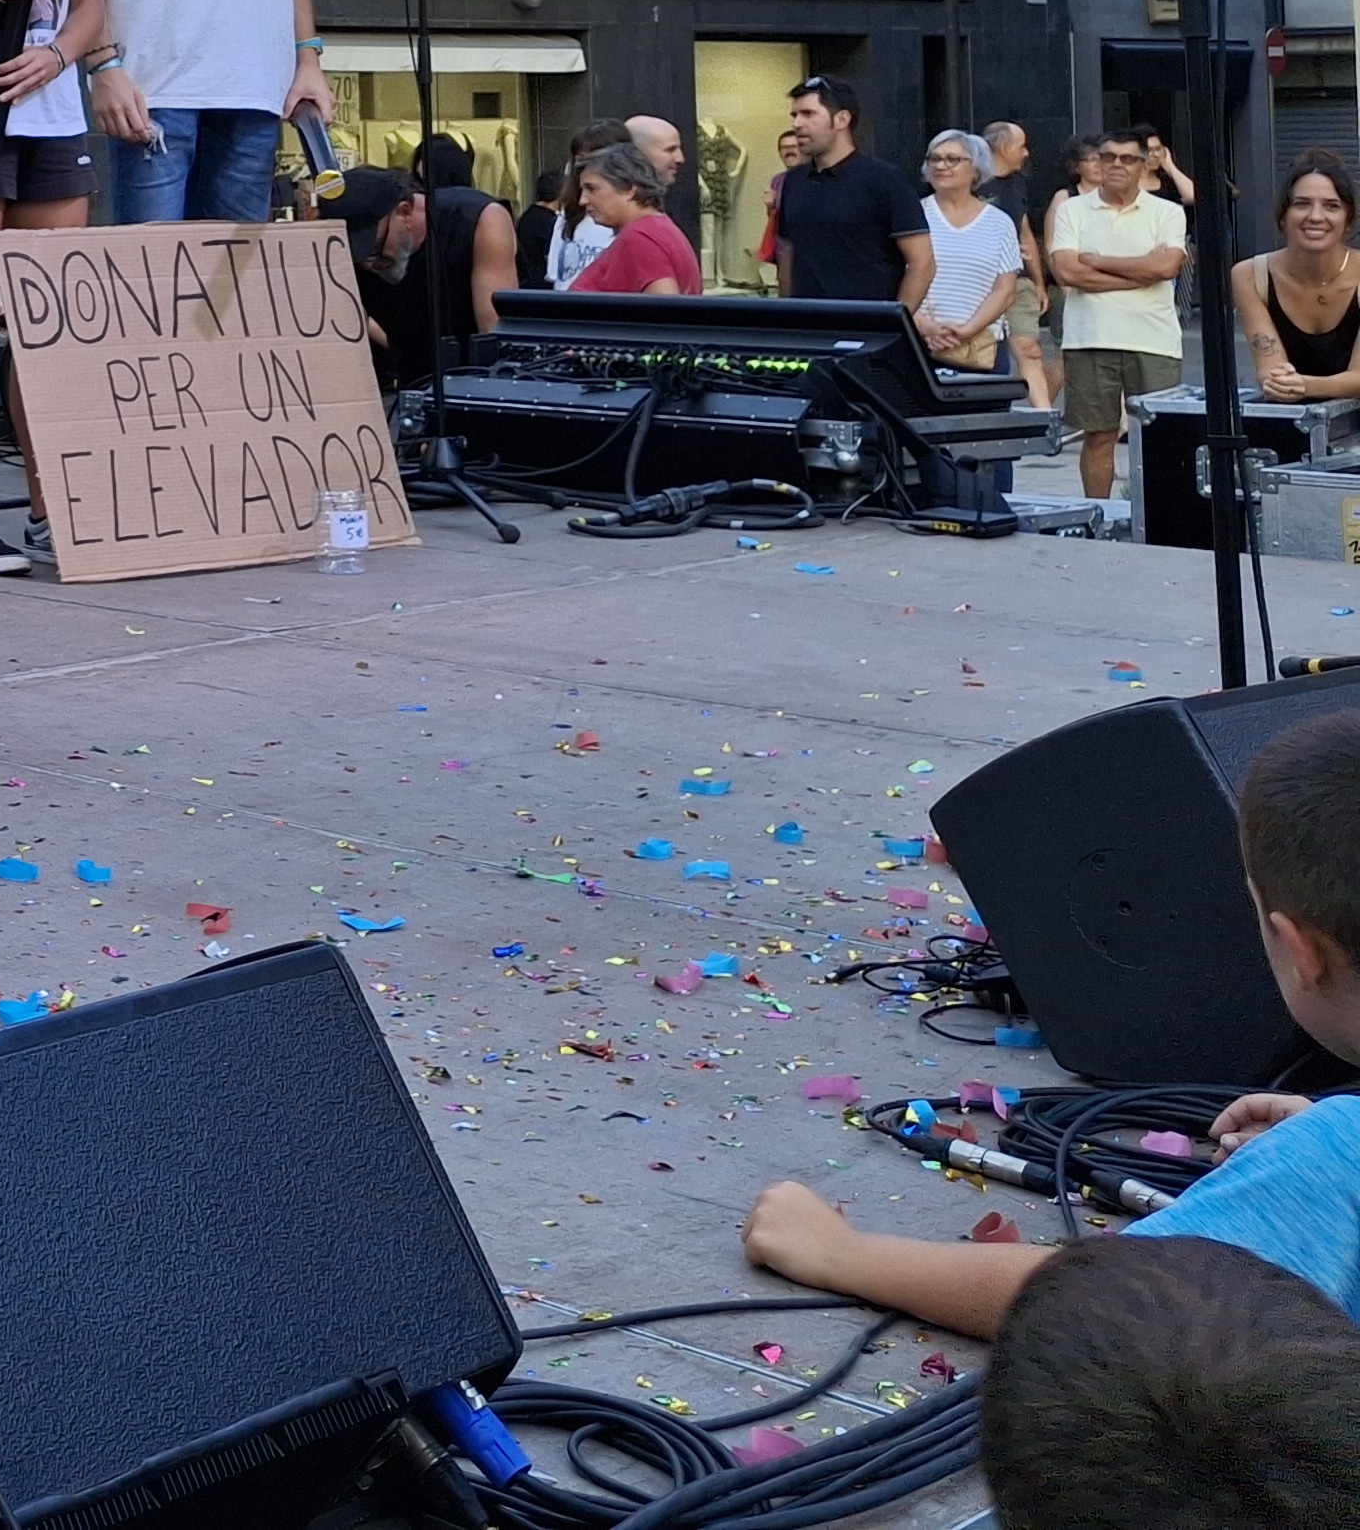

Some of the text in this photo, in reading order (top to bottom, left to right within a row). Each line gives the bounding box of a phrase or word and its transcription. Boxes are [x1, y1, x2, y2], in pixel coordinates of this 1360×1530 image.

[3, 235, 366, 350] DONATIUS
[106, 349, 317, 435] PER UN
[60, 424, 409, 546] ELEVADOR
[346, 527, 363, 540] 5€
